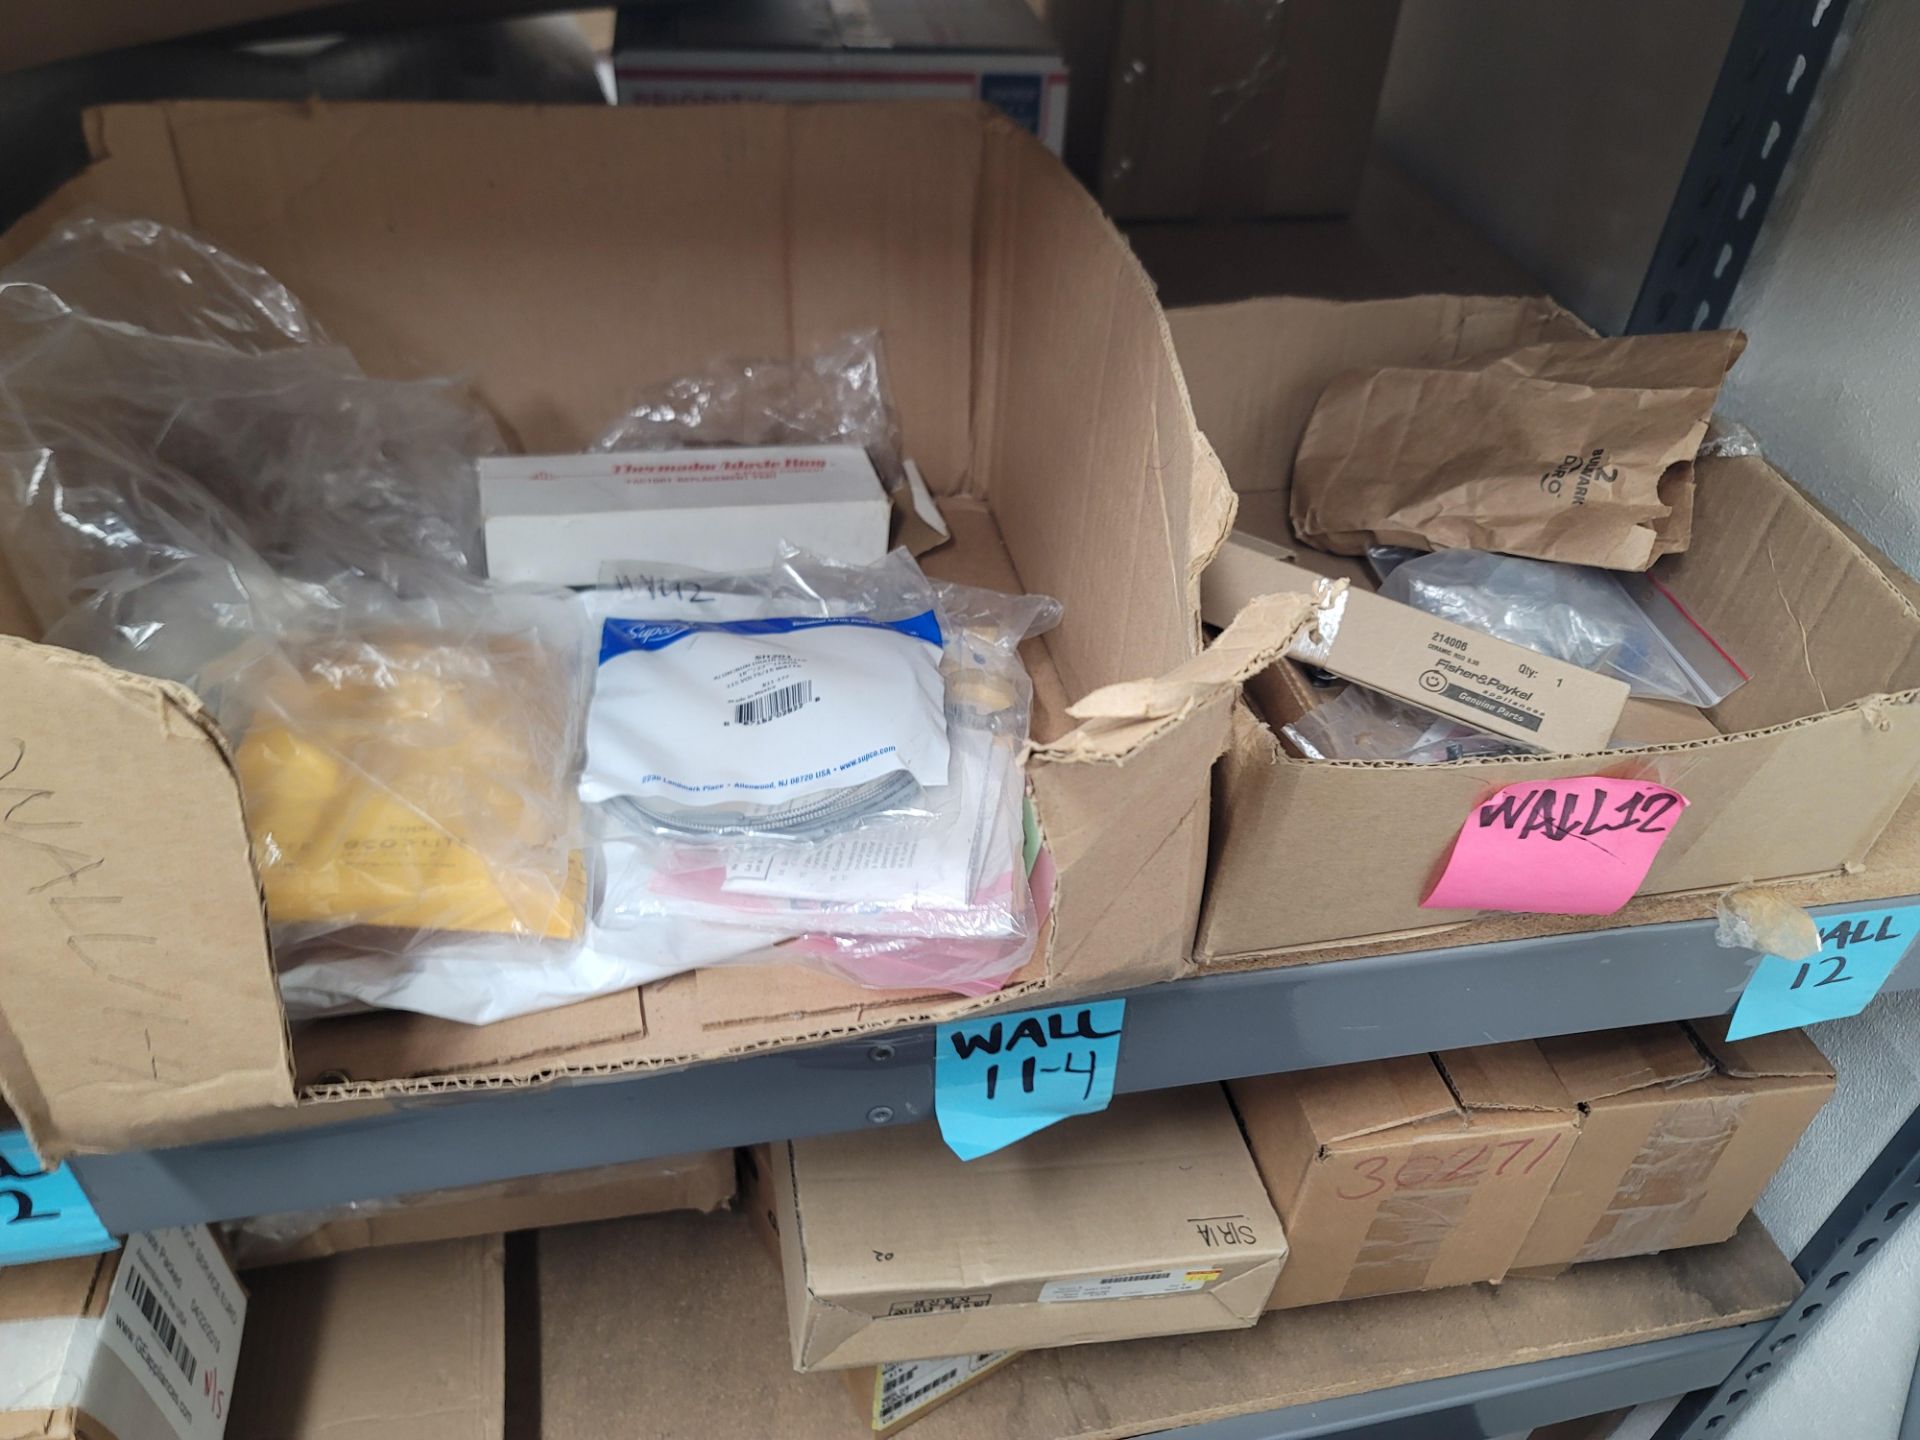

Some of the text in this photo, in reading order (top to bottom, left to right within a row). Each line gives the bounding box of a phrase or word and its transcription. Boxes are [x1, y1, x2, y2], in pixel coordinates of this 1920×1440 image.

[1547, 454, 1577, 494] DURO
[1431, 631, 1469, 652] 214006
[1434, 658, 1533, 701] Fisher&Paykel
[1518, 663, 1563, 688] Qty: 1
[1458, 691, 1525, 722] Genuine Parts
[779, 780, 789, 788] NJ
[815, 768, 832, 779] USA
[839, 745, 896, 772] www.supco.com
[1816, 915, 1901, 949] ALL
[1790, 956, 1853, 990] 12
[951, 1010, 1122, 1060] WALL
[986, 1050, 1096, 1101] 11-4
